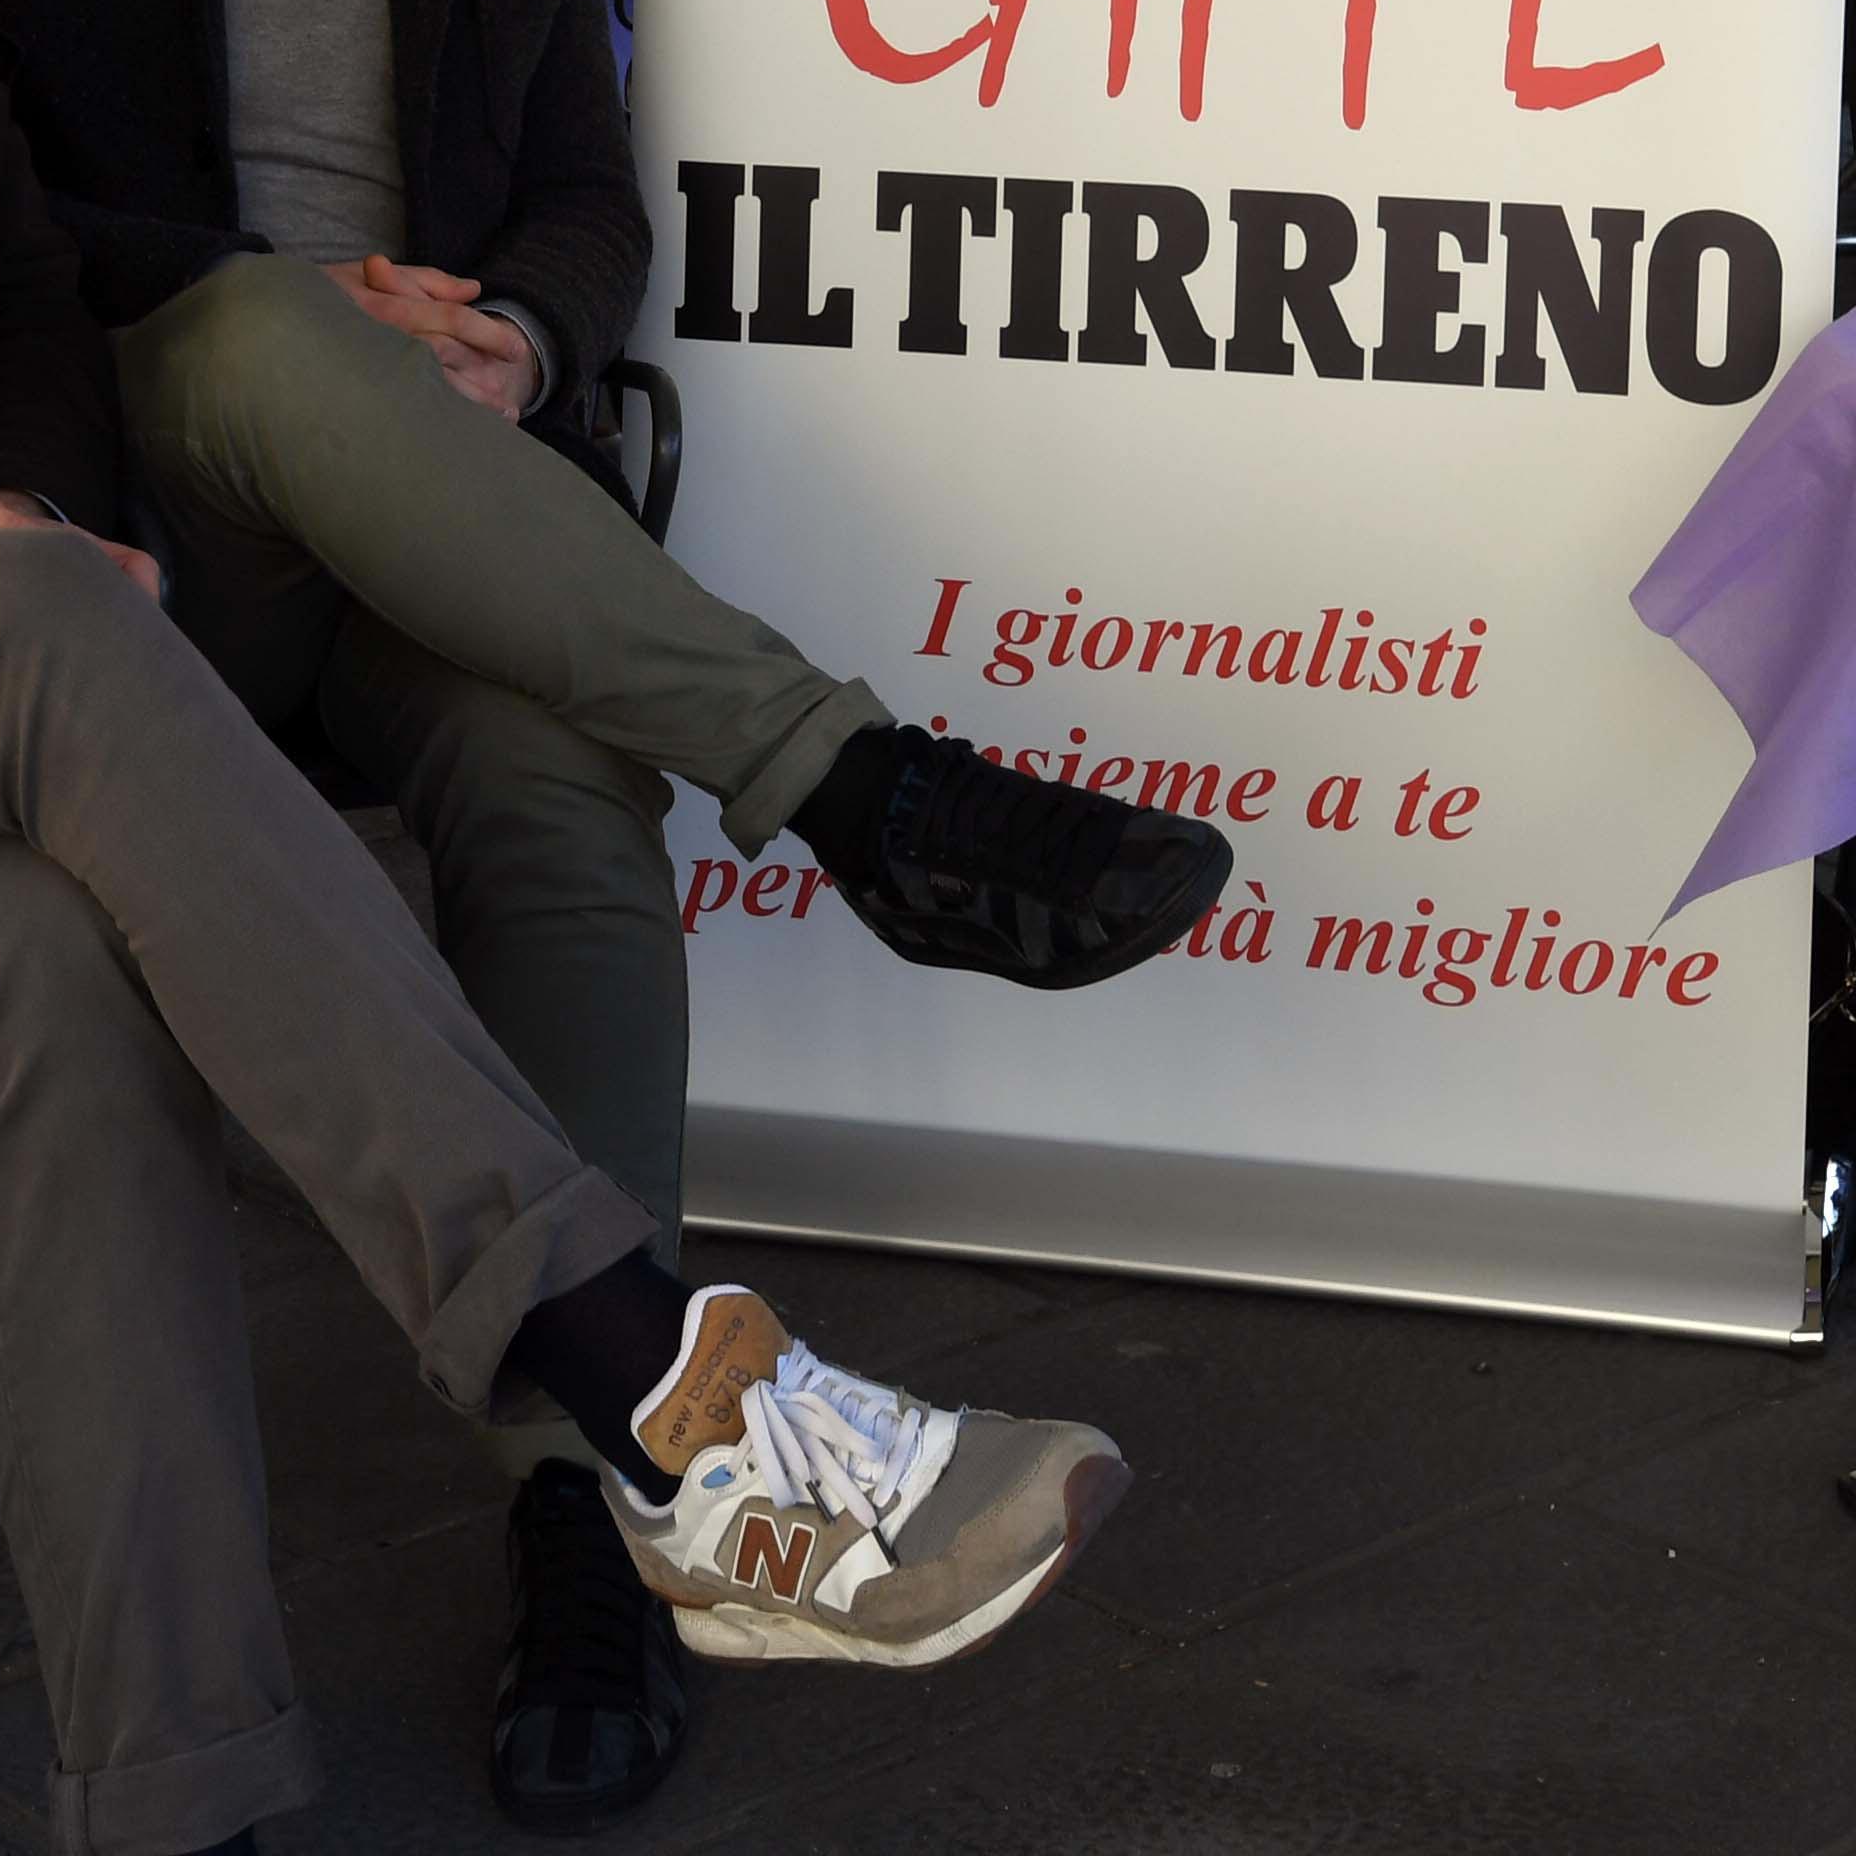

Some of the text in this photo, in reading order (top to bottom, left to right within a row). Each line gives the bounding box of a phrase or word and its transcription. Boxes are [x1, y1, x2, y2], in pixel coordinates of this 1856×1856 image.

[674, 159, 1783, 406] IL TIRRENO
[915, 578, 1489, 700] I giornalisti
[1305, 775, 1363, 832] a
[1394, 770, 1482, 842] te
[682, 857, 834, 934] per
[1305, 898, 1721, 1008] migliore
[668, 1317, 745, 1447] new balance
[705, 1366, 751, 1424] 878
[733, 1512, 816, 1603] N
